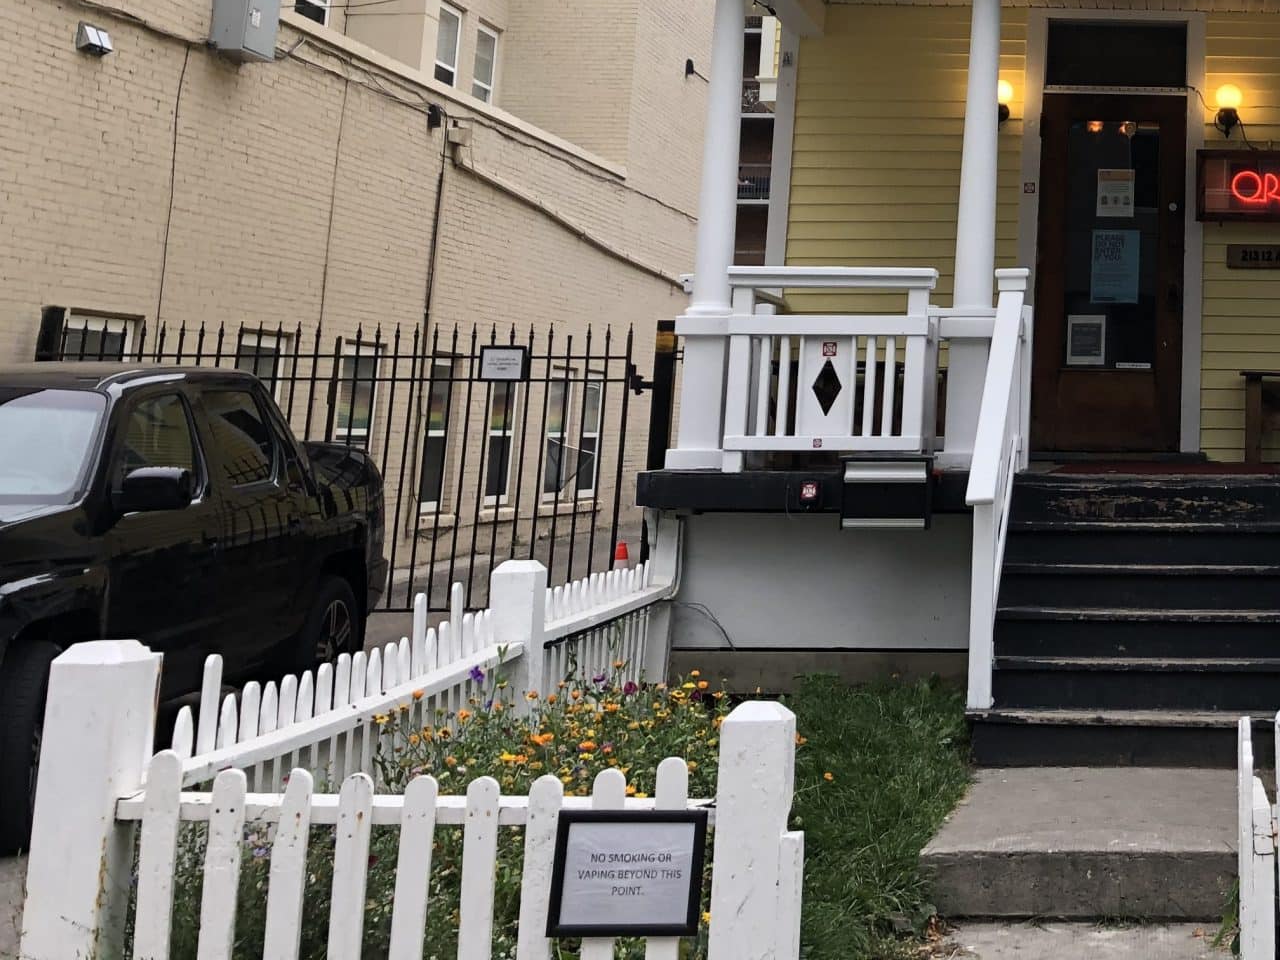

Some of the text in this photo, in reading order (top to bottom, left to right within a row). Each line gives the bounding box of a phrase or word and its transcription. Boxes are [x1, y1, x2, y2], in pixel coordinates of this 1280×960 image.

[590, 853, 672, 863] NO SMOKING OR
[577, 869, 683, 880] VAPING BEYOND THIS
[611, 886, 645, 896] POINT.
